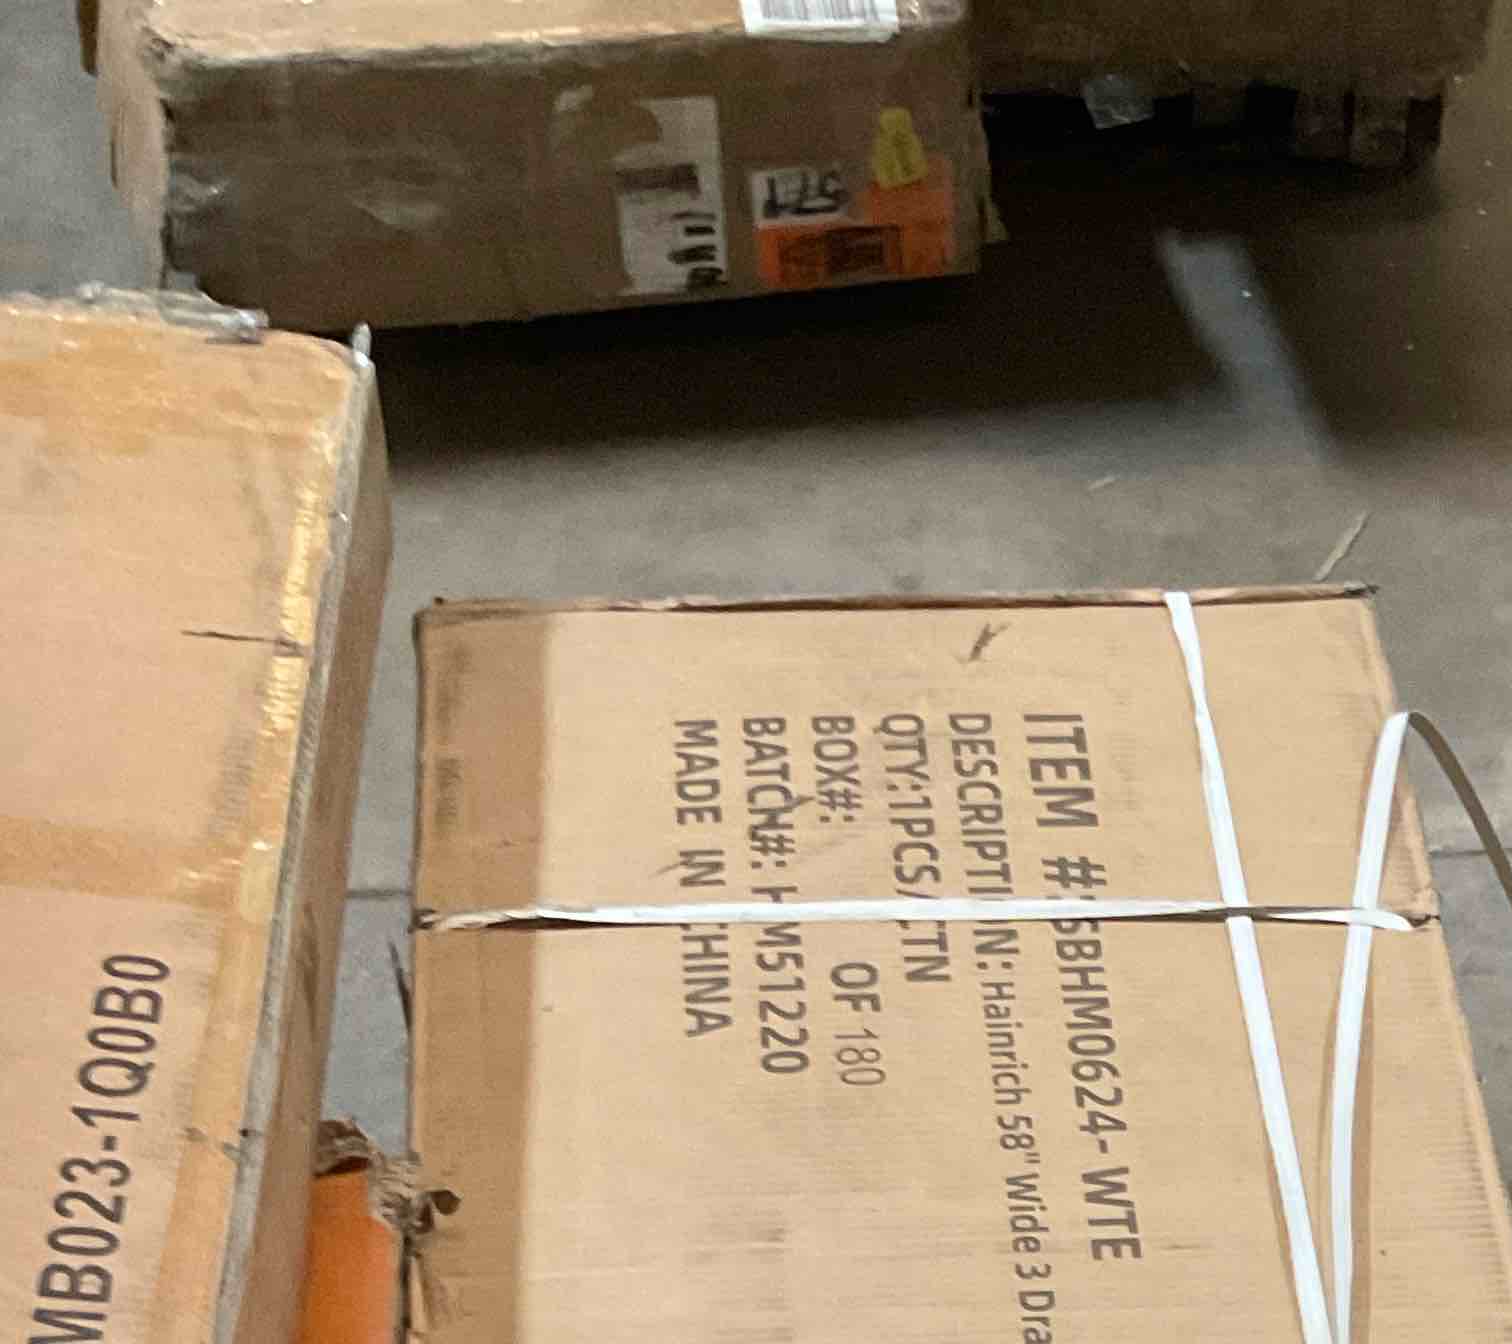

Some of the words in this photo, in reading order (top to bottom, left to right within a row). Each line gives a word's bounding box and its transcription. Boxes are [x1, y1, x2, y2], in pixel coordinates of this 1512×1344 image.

[674, 719, 722, 825] MADE
[743, 717, 797, 870] BATCH#:
[812, 715, 861, 824] BOX#:
[679, 849, 726, 887] IN
[949, 713, 1020, 970] DESCRIPTIN:
[830, 962, 881, 1012] OF
[1024, 714, 1100, 827] ITEM
[1082, 1167, 1142, 1260] WTE
[834, 1027, 886, 1086] 180
[981, 982, 1032, 1104] Hainrich
[997, 1114, 1040, 1163] 58"
[1006, 1173, 1049, 1253] Wide
[1015, 1264, 1051, 1279] 3
